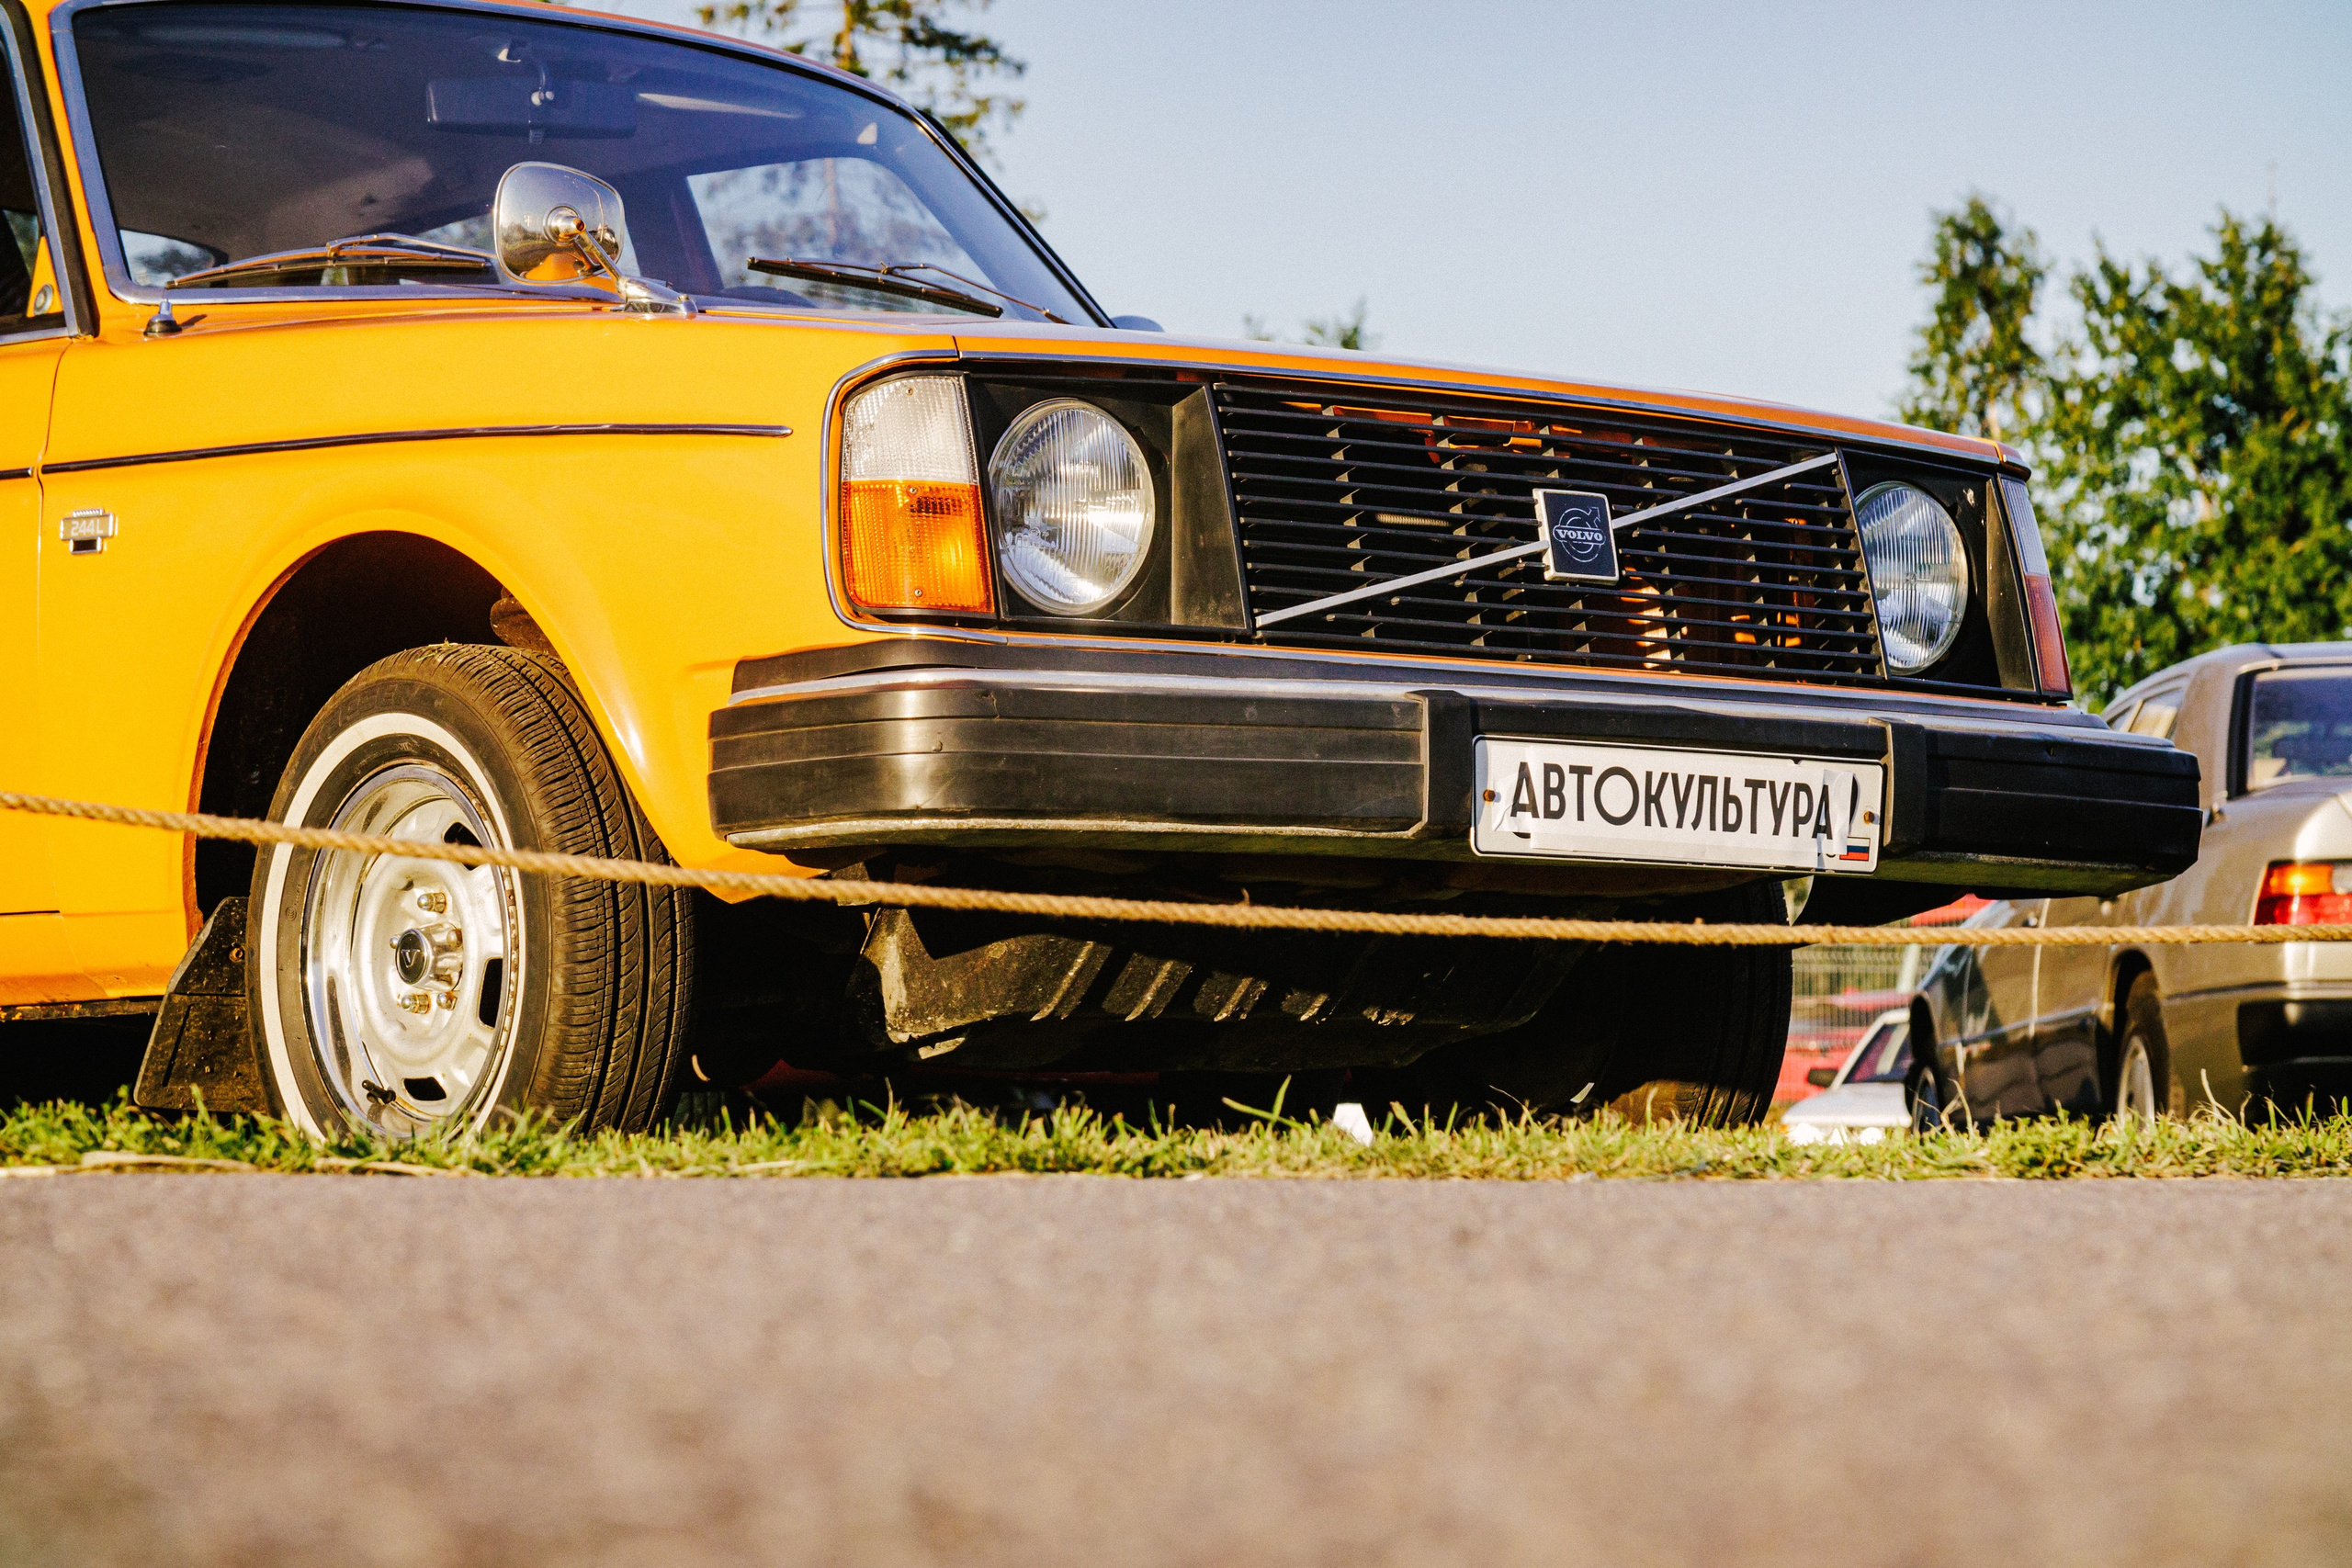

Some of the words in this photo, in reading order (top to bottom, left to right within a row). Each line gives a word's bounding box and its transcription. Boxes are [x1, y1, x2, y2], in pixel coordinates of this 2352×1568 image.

[1555, 529, 1603, 541] VOLVO
[1510, 761, 1833, 840] АВТОКУЛЬТУРА
[400, 949, 421, 968] V
